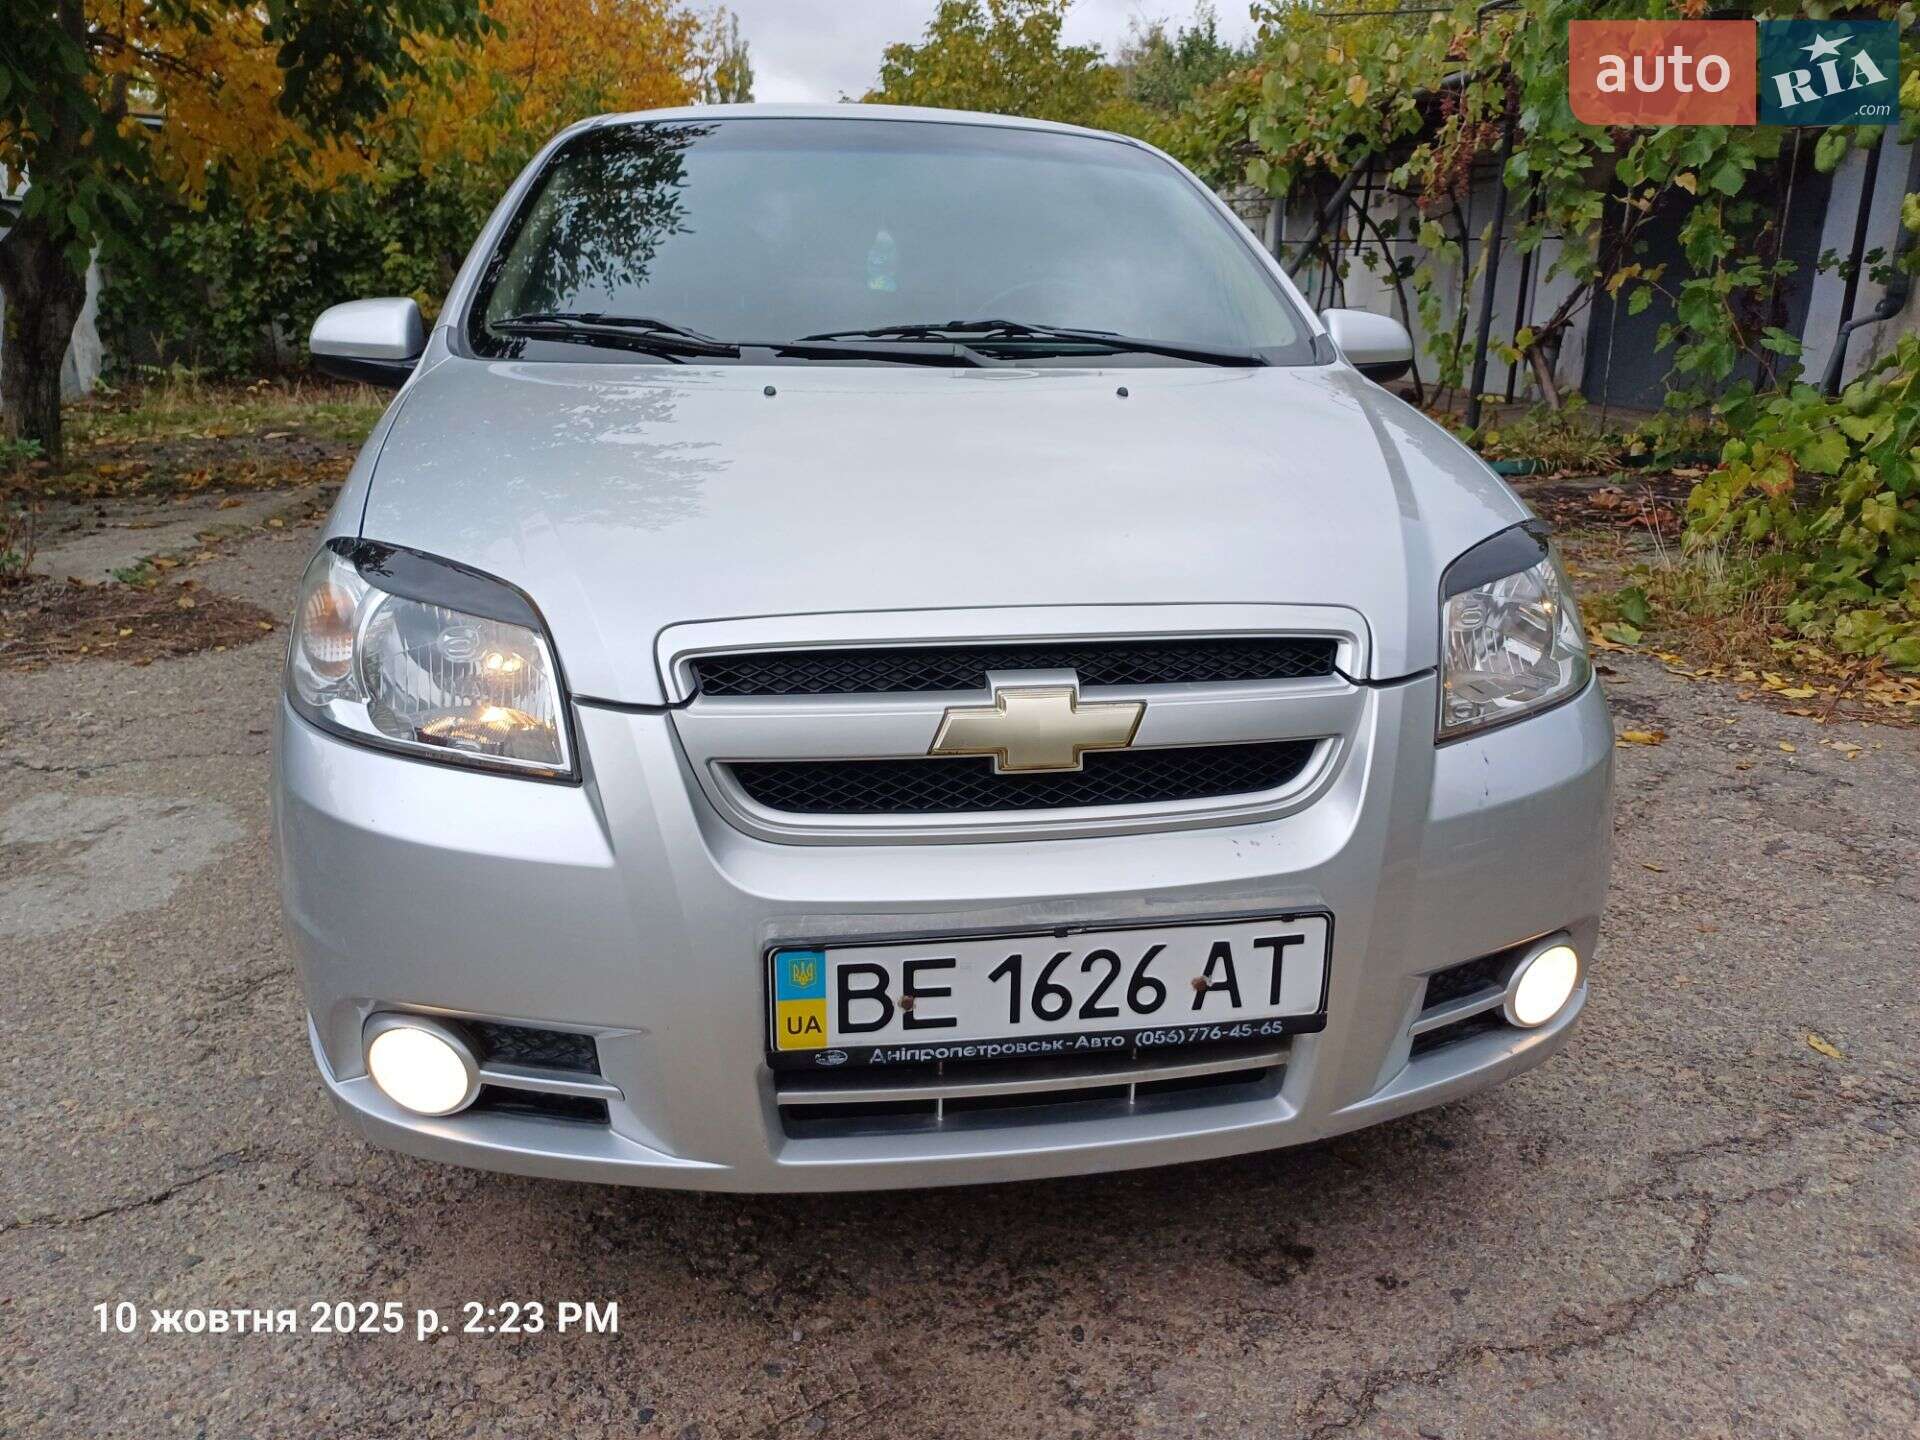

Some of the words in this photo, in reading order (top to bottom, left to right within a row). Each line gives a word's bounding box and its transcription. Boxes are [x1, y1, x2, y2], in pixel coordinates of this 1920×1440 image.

[837, 957, 957, 1034] BE
[987, 944, 1168, 1024] 1626
[1191, 934, 1305, 1011] AT
[786, 1016, 822, 1035] UA
